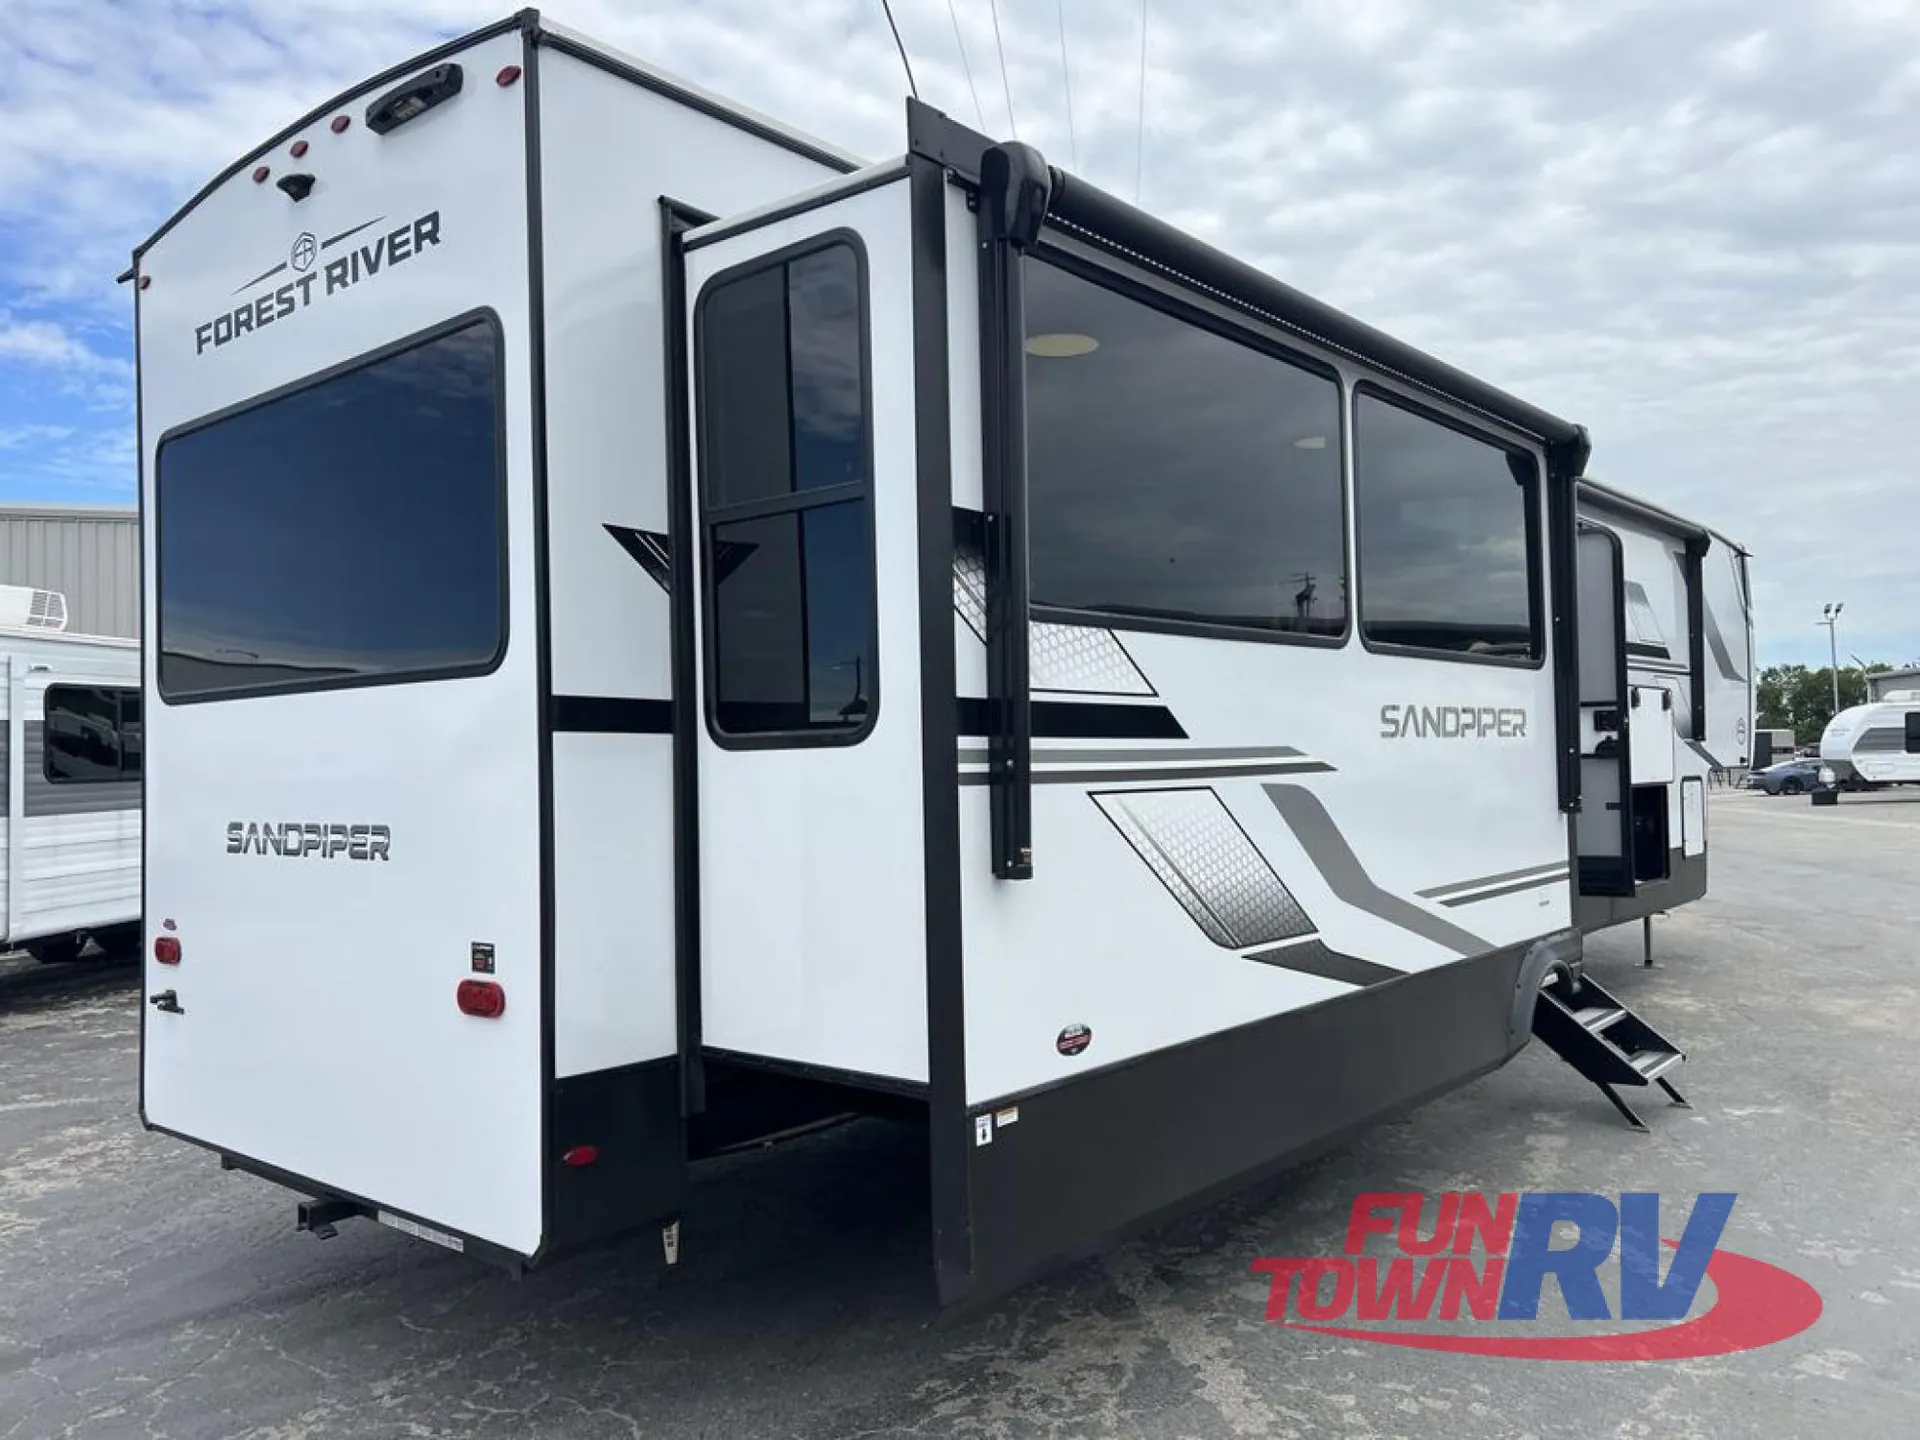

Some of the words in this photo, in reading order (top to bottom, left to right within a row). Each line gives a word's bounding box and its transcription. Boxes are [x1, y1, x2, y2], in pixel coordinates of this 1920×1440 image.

[195, 271, 317, 355] FOREST
[324, 210, 441, 296] RIVER
[1380, 704, 1527, 738] SANDPIPER
[226, 821, 391, 861] SANDPIPER
